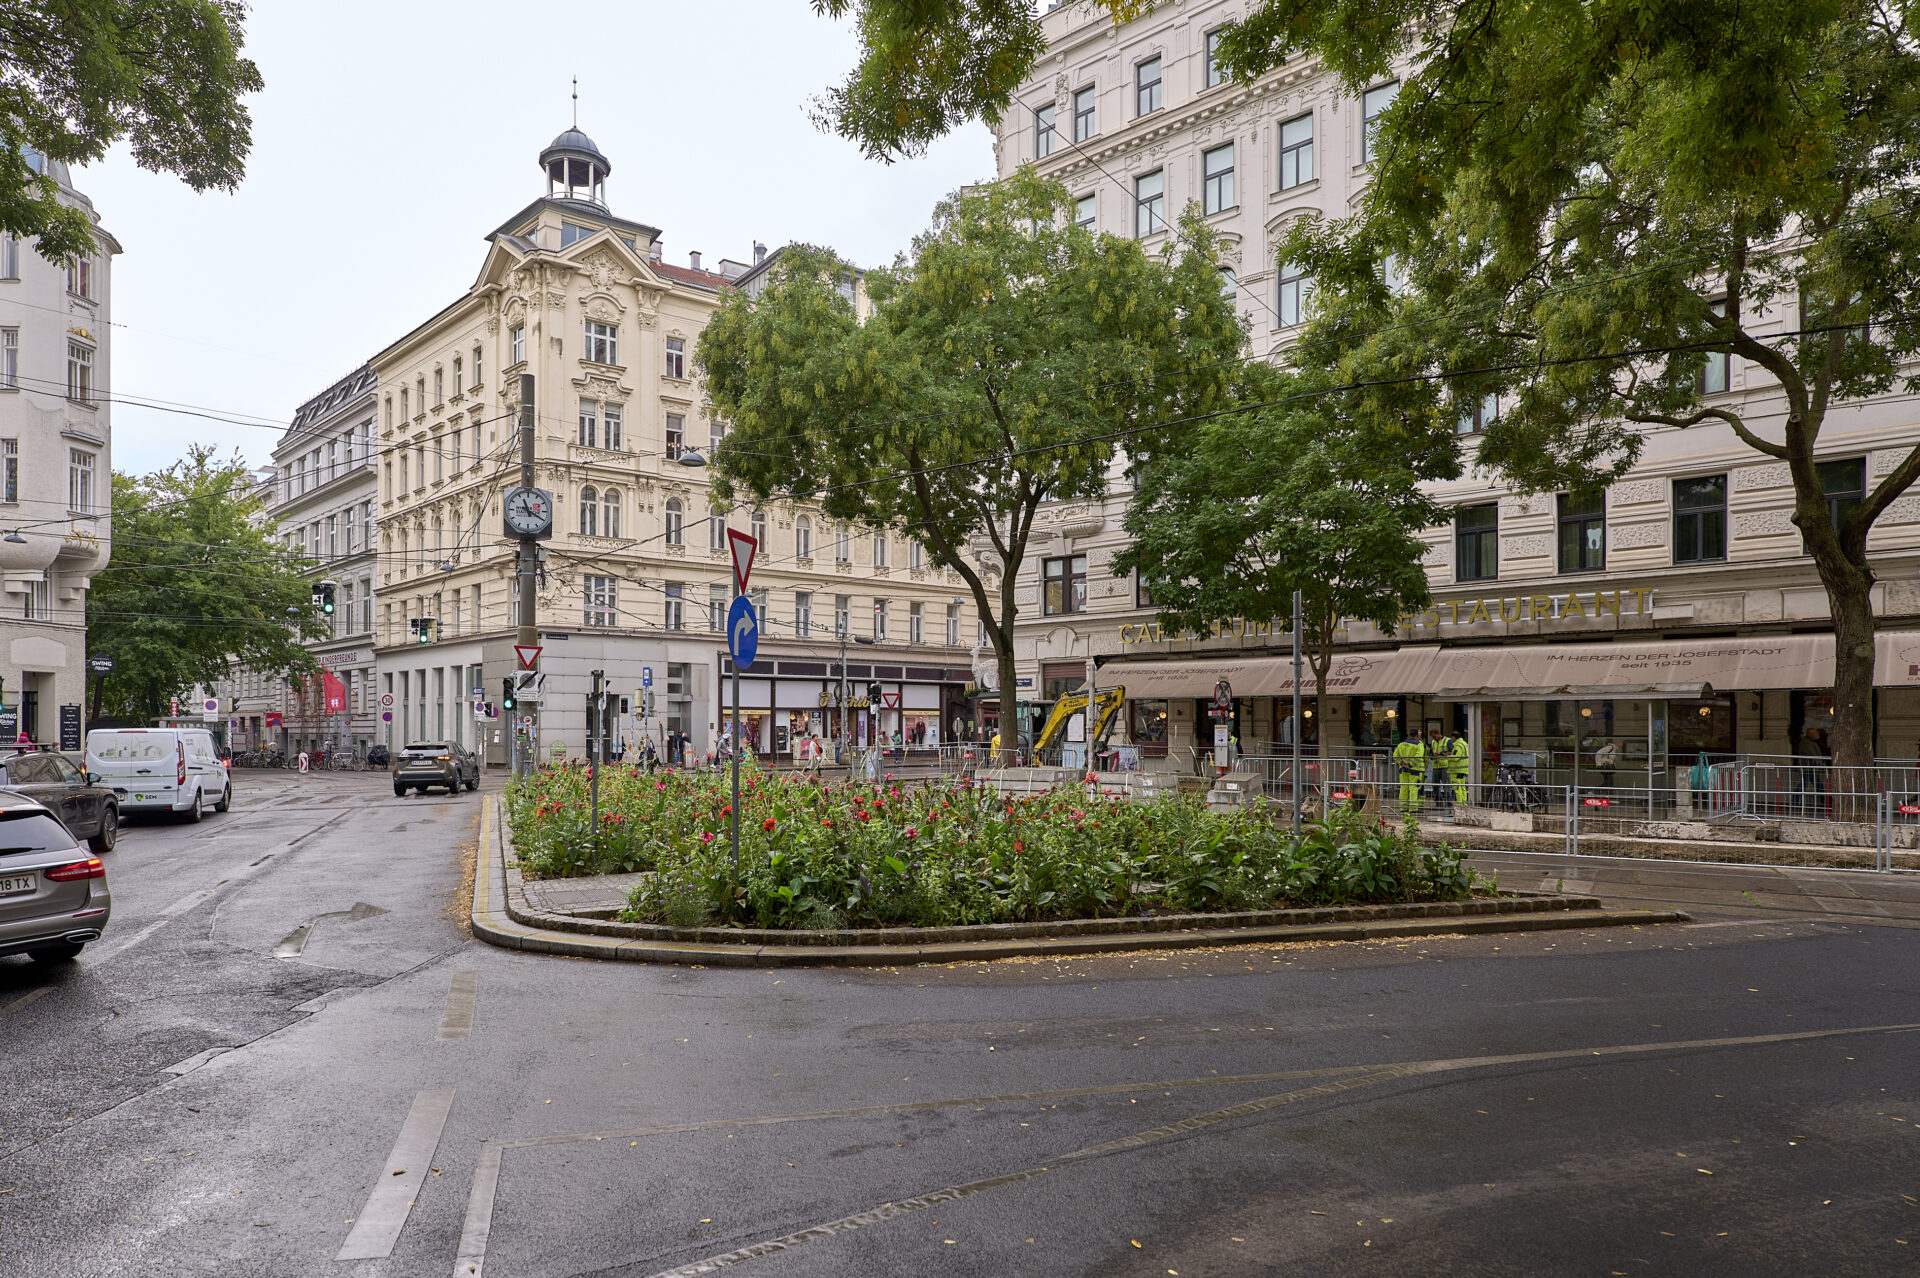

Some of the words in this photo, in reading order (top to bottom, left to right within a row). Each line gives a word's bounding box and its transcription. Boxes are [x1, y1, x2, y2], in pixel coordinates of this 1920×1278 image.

[1373, 587, 1653, 631] ESTAURANT
[1568, 654, 1631, 662] HERZEN
[1673, 648, 1786, 658] JOSEFSTADT
[15, 877, 30, 889] TX
